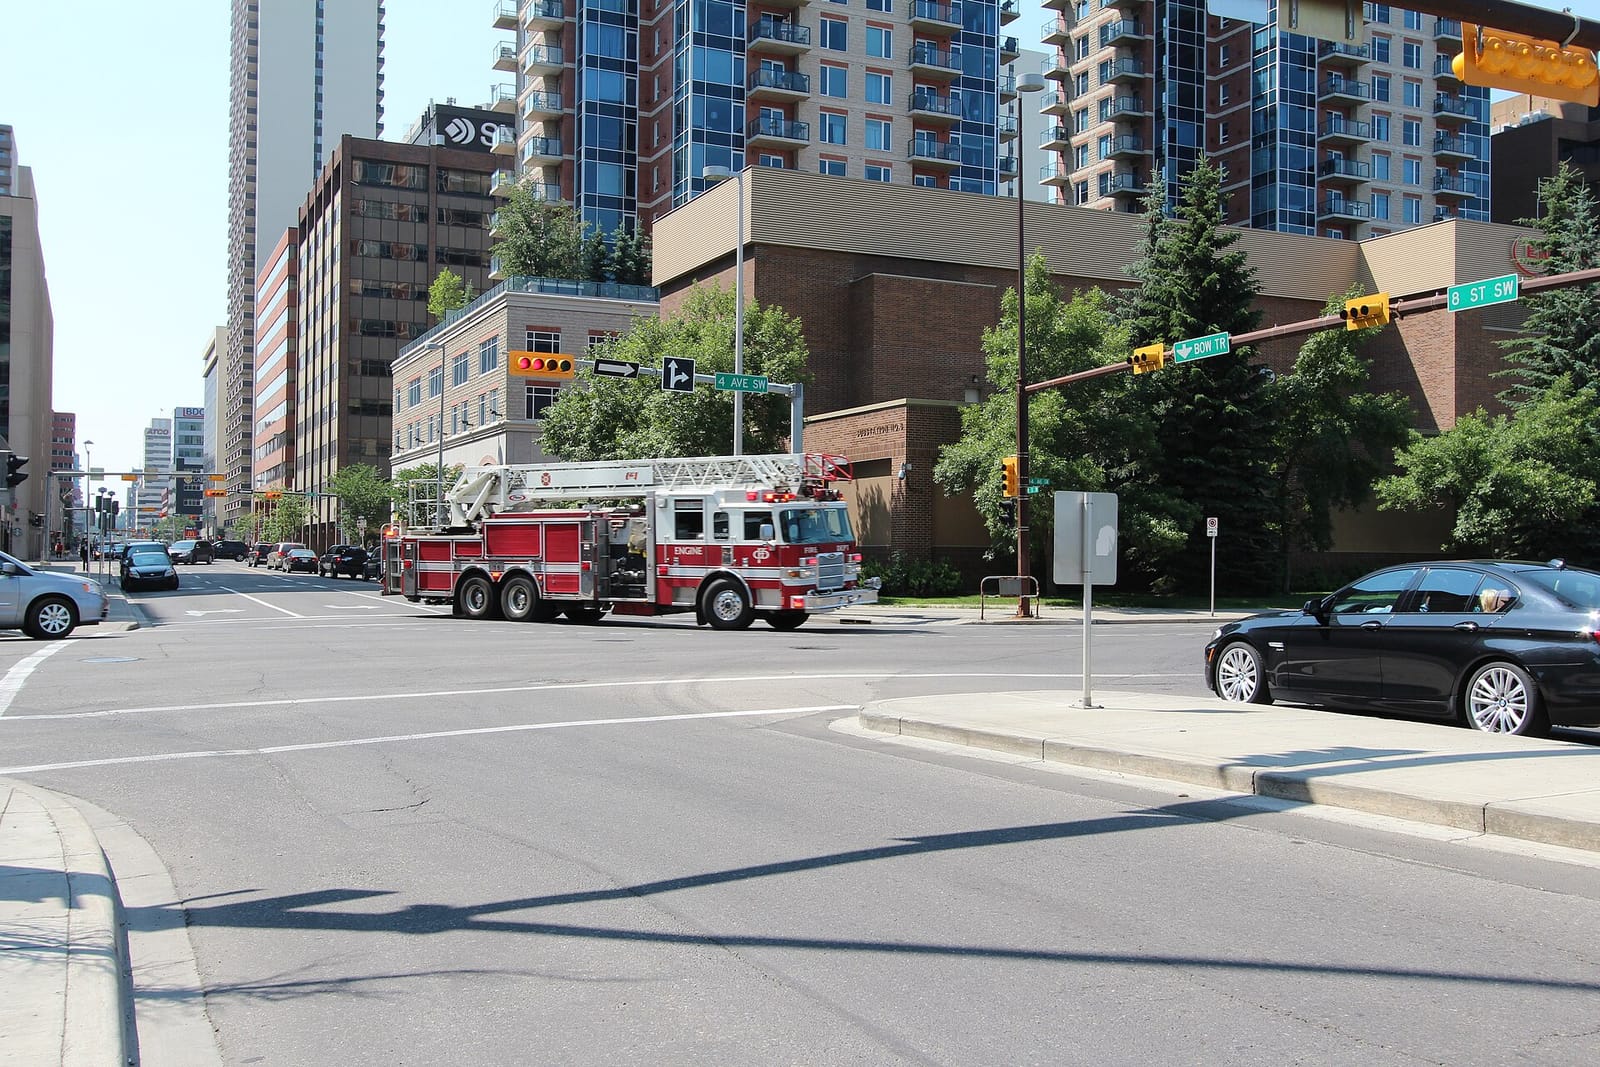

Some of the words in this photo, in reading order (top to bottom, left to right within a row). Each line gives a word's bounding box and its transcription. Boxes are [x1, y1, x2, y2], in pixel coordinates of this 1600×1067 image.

[1451, 291, 1460, 306] 8
[1470, 285, 1486, 302] ST
[1494, 280, 1514, 298] SW
[1194, 340, 1212, 355] BOW
[1215, 337, 1226, 350] TR
[718, 376, 725, 387] 4
[730, 377, 749, 388] AVE
[752, 379, 766, 390] SW
[674, 546, 704, 556] ENGINE
[804, 546, 818, 554] FIRE
